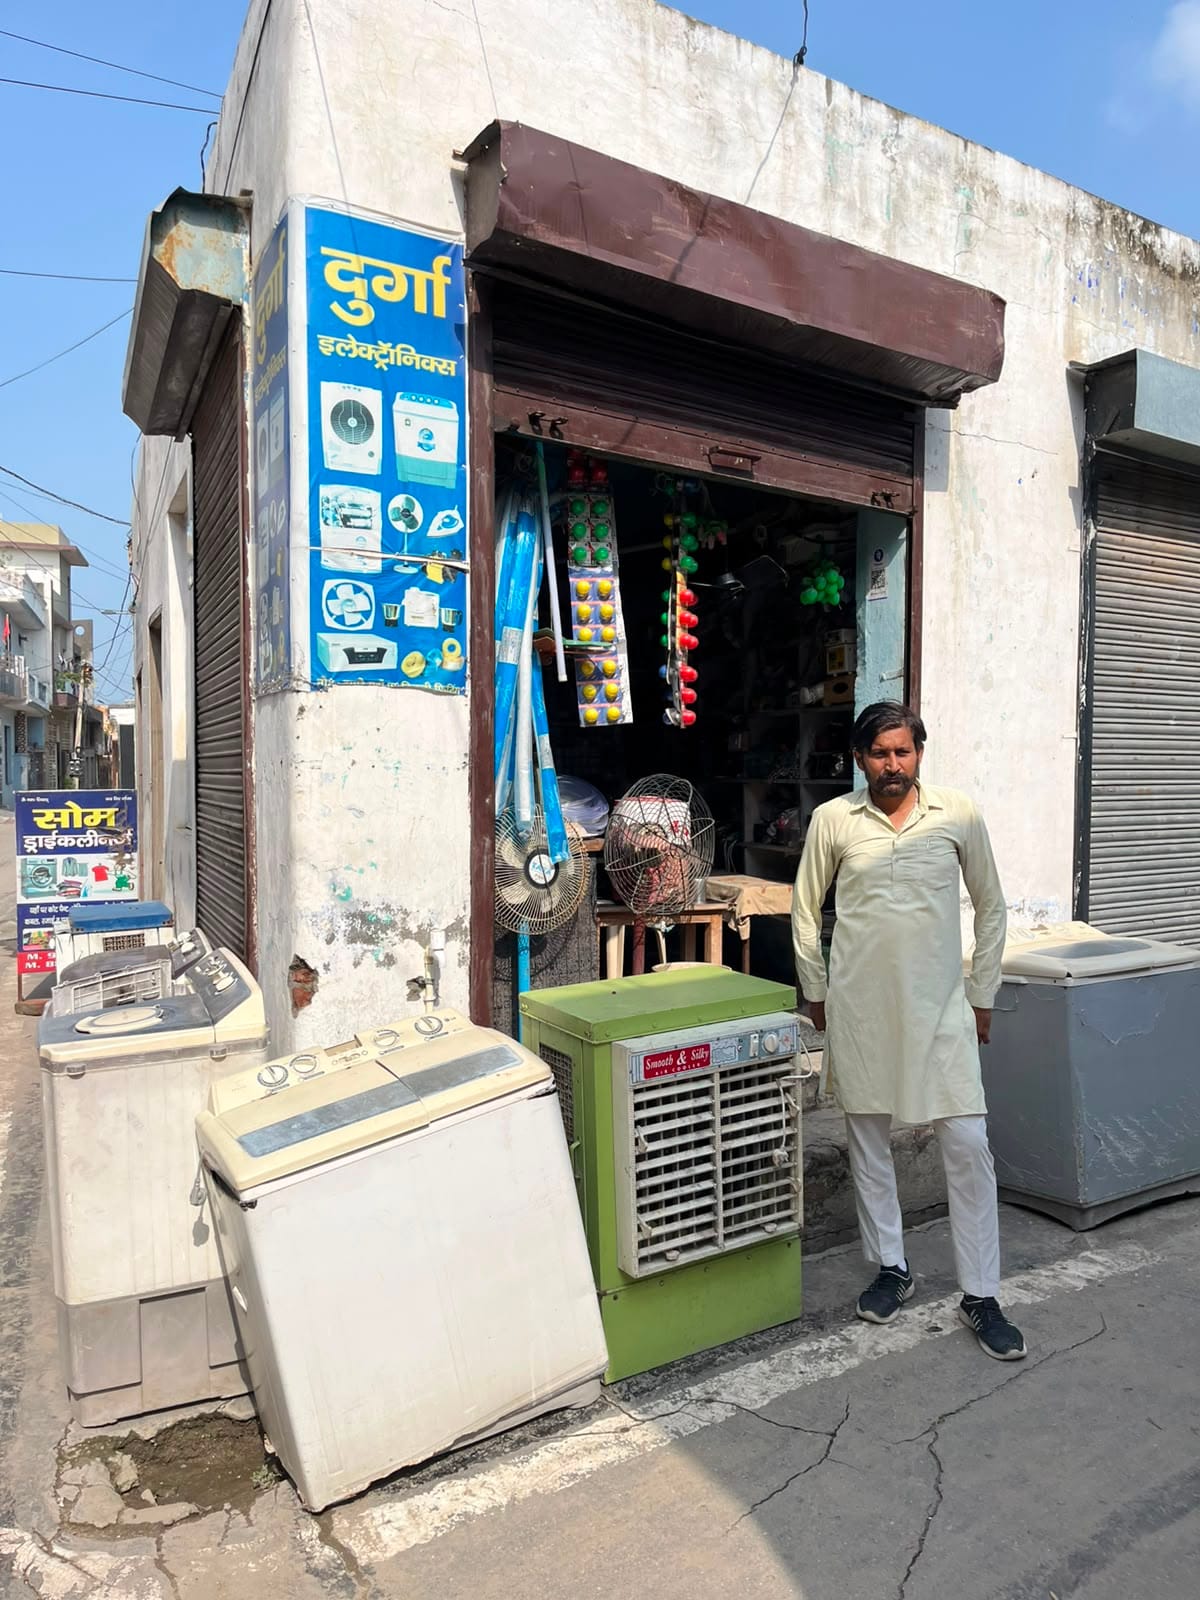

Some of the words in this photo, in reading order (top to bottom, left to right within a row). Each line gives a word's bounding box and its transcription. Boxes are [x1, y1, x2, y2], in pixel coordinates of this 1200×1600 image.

[256, 229, 287, 365] दुर्गा
[320, 245, 451, 327] दुर्गा
[317, 333, 457, 377] इलेक्ट्रॉनिक्स
[32, 800, 119, 829] सोम
[645, 1054, 674, 1071] Smooth
[676, 1050, 687, 1066] &
[690, 1047, 710, 1062] Silky
